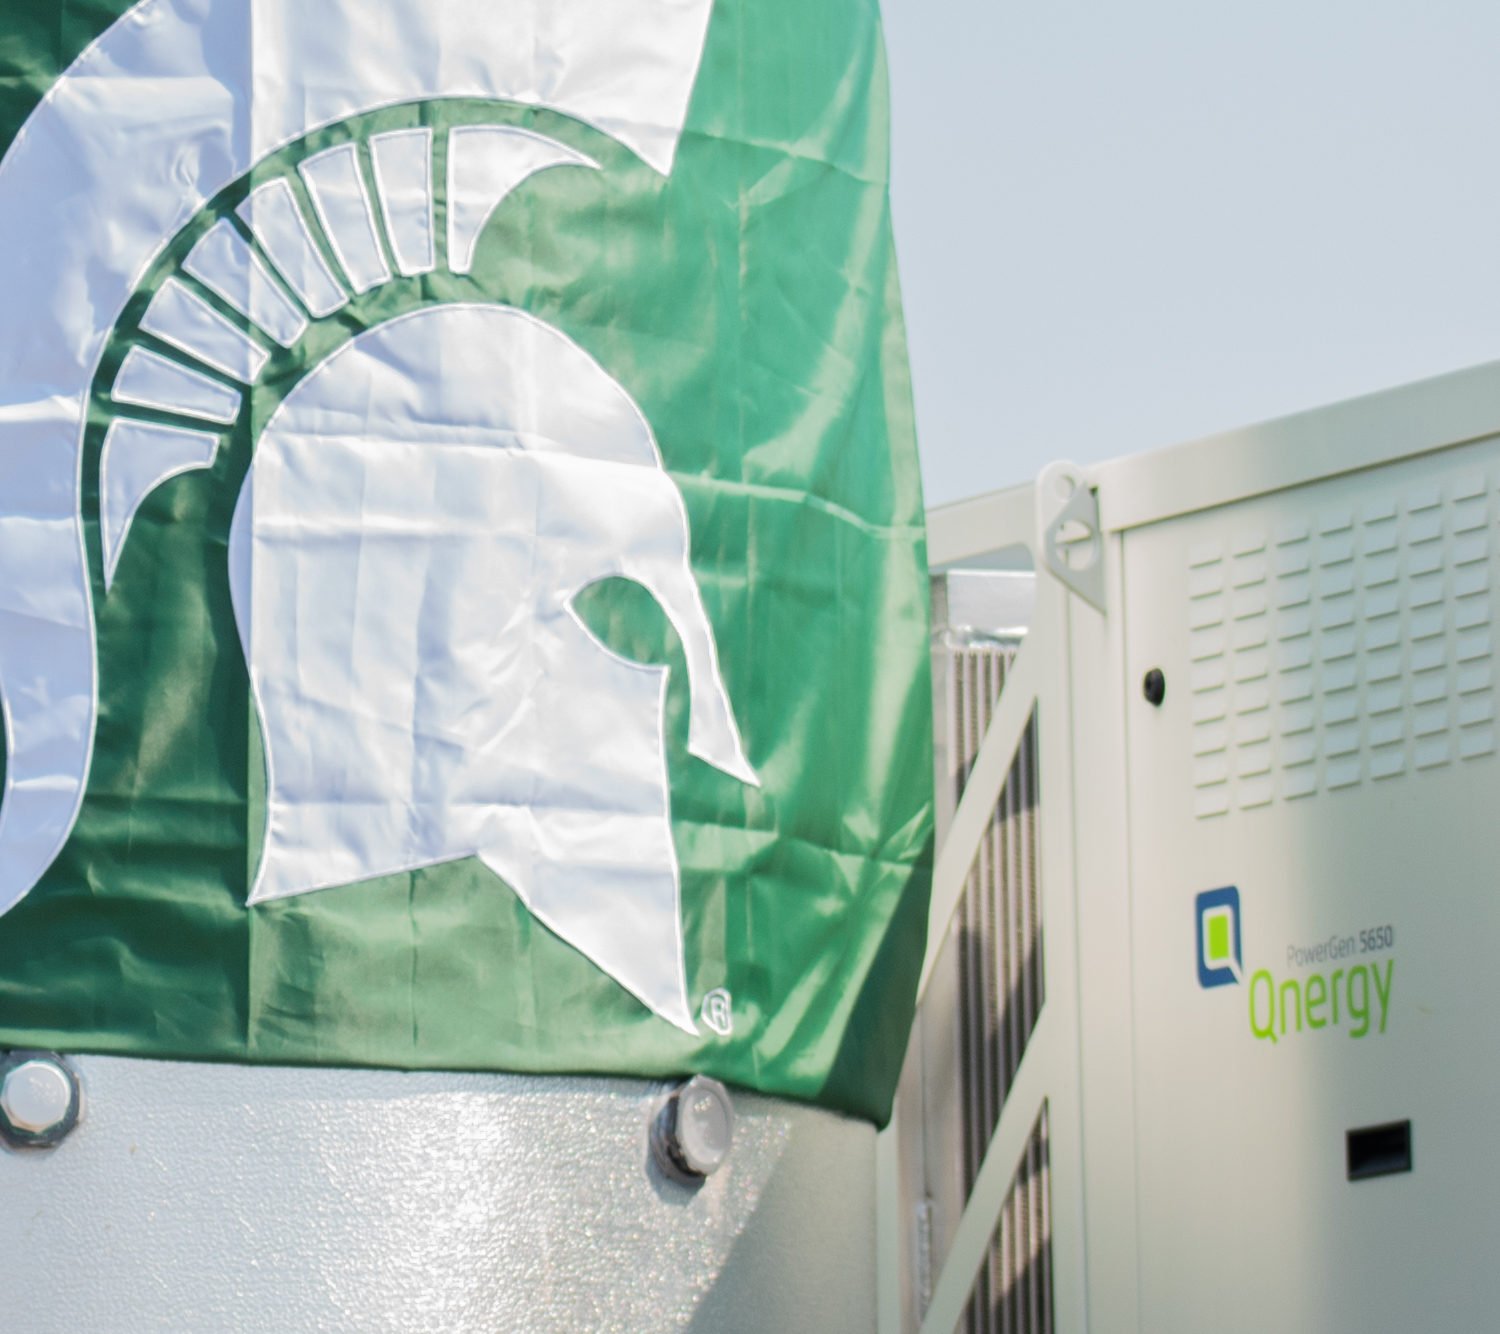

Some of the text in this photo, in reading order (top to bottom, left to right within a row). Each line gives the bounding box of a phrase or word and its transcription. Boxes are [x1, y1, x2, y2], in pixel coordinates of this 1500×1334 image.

[1287, 924, 1393, 967] PowerGen 5650
[1249, 958, 1395, 1045] Qnergy
